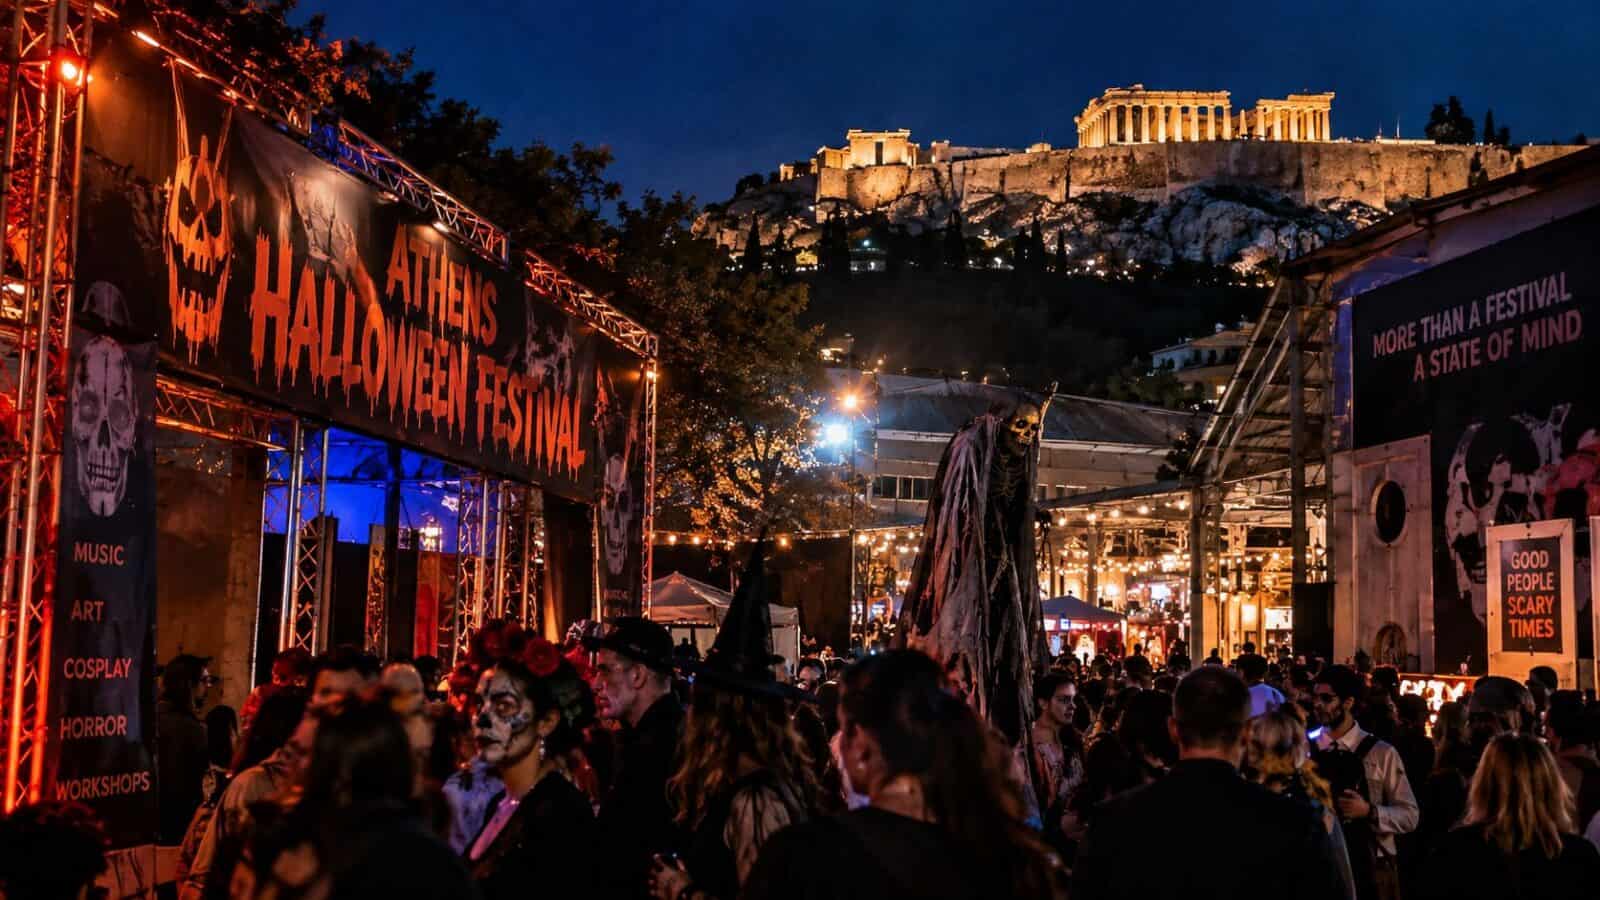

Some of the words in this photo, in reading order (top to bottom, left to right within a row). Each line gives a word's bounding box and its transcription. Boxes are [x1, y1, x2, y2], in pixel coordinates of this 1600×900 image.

[387, 223, 497, 346] ATHENS
[1373, 322, 1417, 358] MORE
[1420, 305, 1464, 343] THAN
[1469, 301, 1480, 330] A
[1486, 271, 1572, 324] FESTIVAL
[250, 226, 470, 446] HALLOWEEN
[475, 354, 585, 482] FESTIVAL
[1413, 353, 1425, 382] A
[1429, 338, 1481, 377] STATE
[1487, 328, 1514, 361] OF
[1521, 309, 1582, 352] MIND
[74, 541, 125, 566] MUSIC
[1511, 551, 1549, 570] GOOD
[1507, 572, 1554, 592] PEOPLE
[71, 599, 104, 622] ART
[1508, 595, 1555, 615] SCARY
[1509, 618, 1554, 638] TIMES
[63, 657, 132, 679] COSPLAY
[60, 714, 128, 740] HORROR
[55, 771, 150, 801] WORKSHOPS
